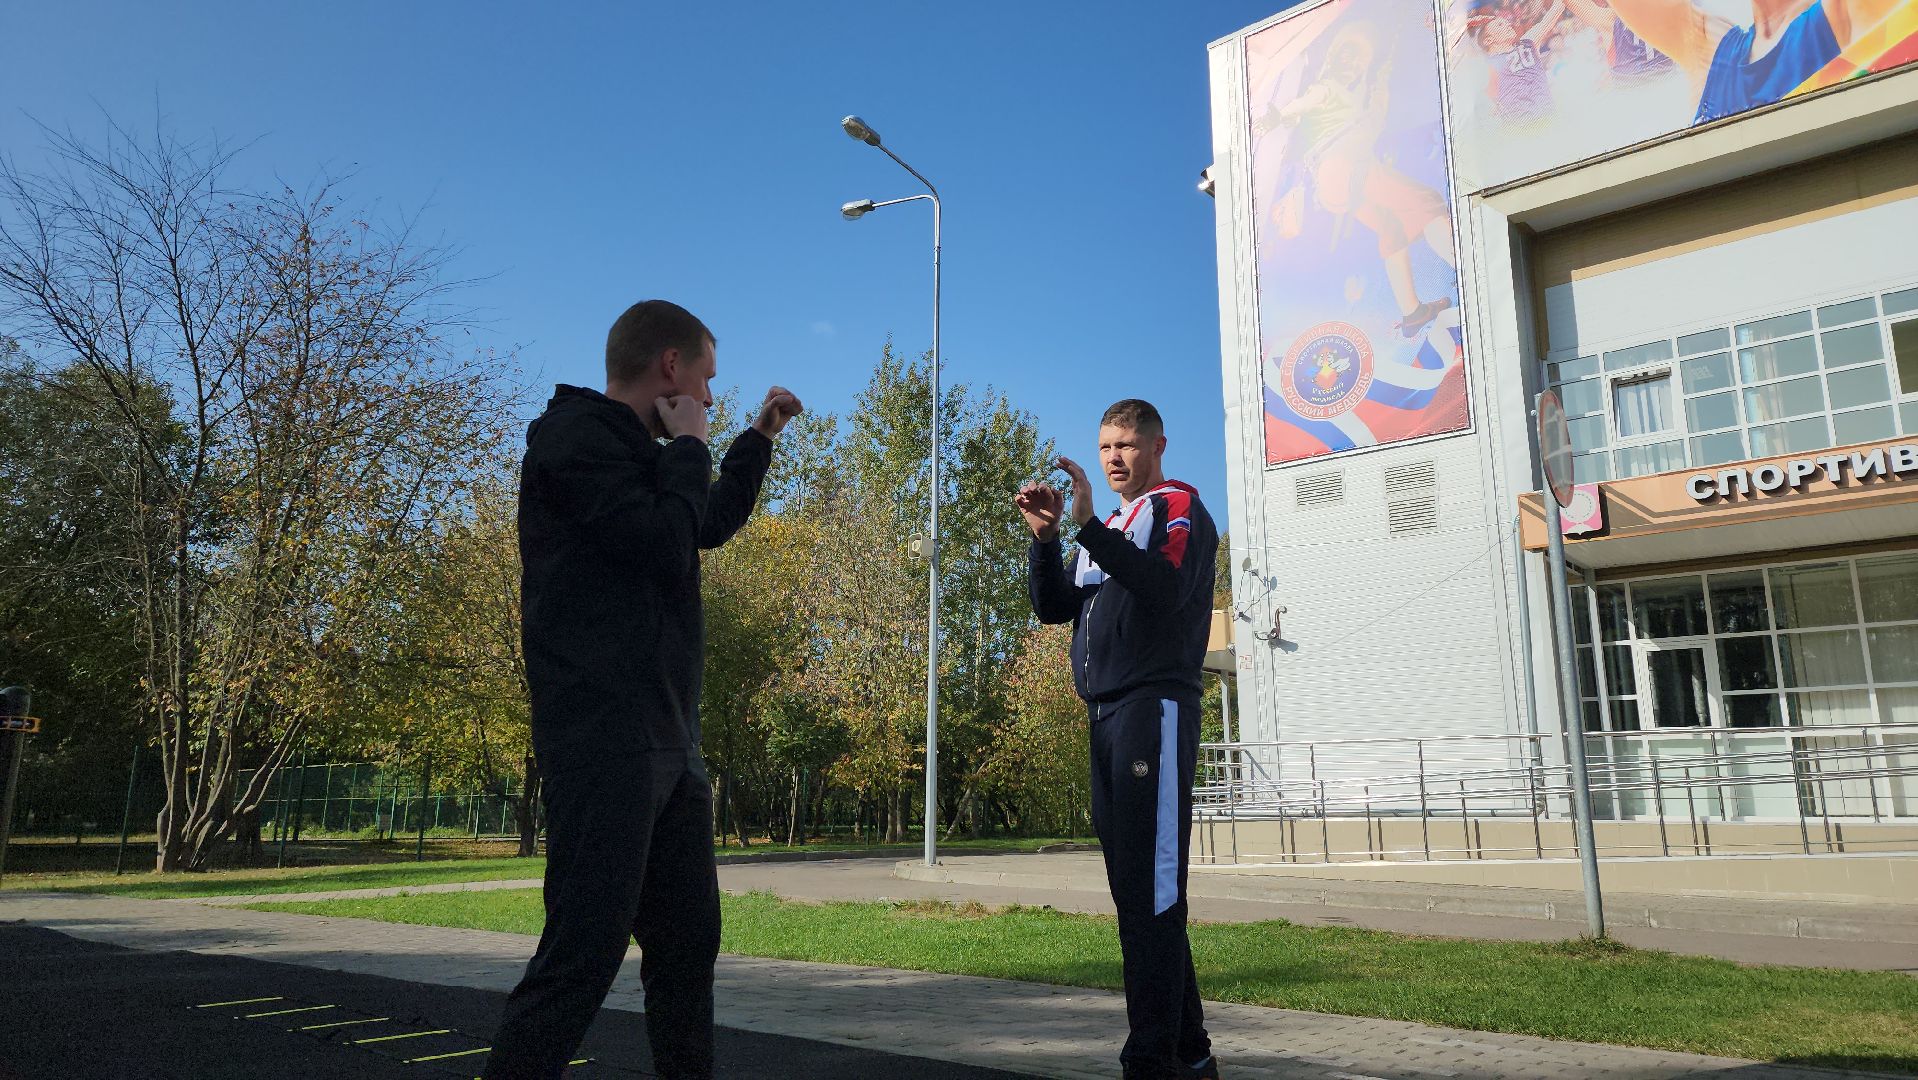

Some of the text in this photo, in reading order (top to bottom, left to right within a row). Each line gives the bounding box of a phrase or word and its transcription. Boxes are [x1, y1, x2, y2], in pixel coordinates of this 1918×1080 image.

[1509, 45, 1535, 73] 20
[1344, 328, 1369, 359] ШКОЛА
[1286, 373, 1369, 416] РУССКИЙ МЕДВЕДЬ
[1685, 444, 1918, 500] СПОРТИВ
